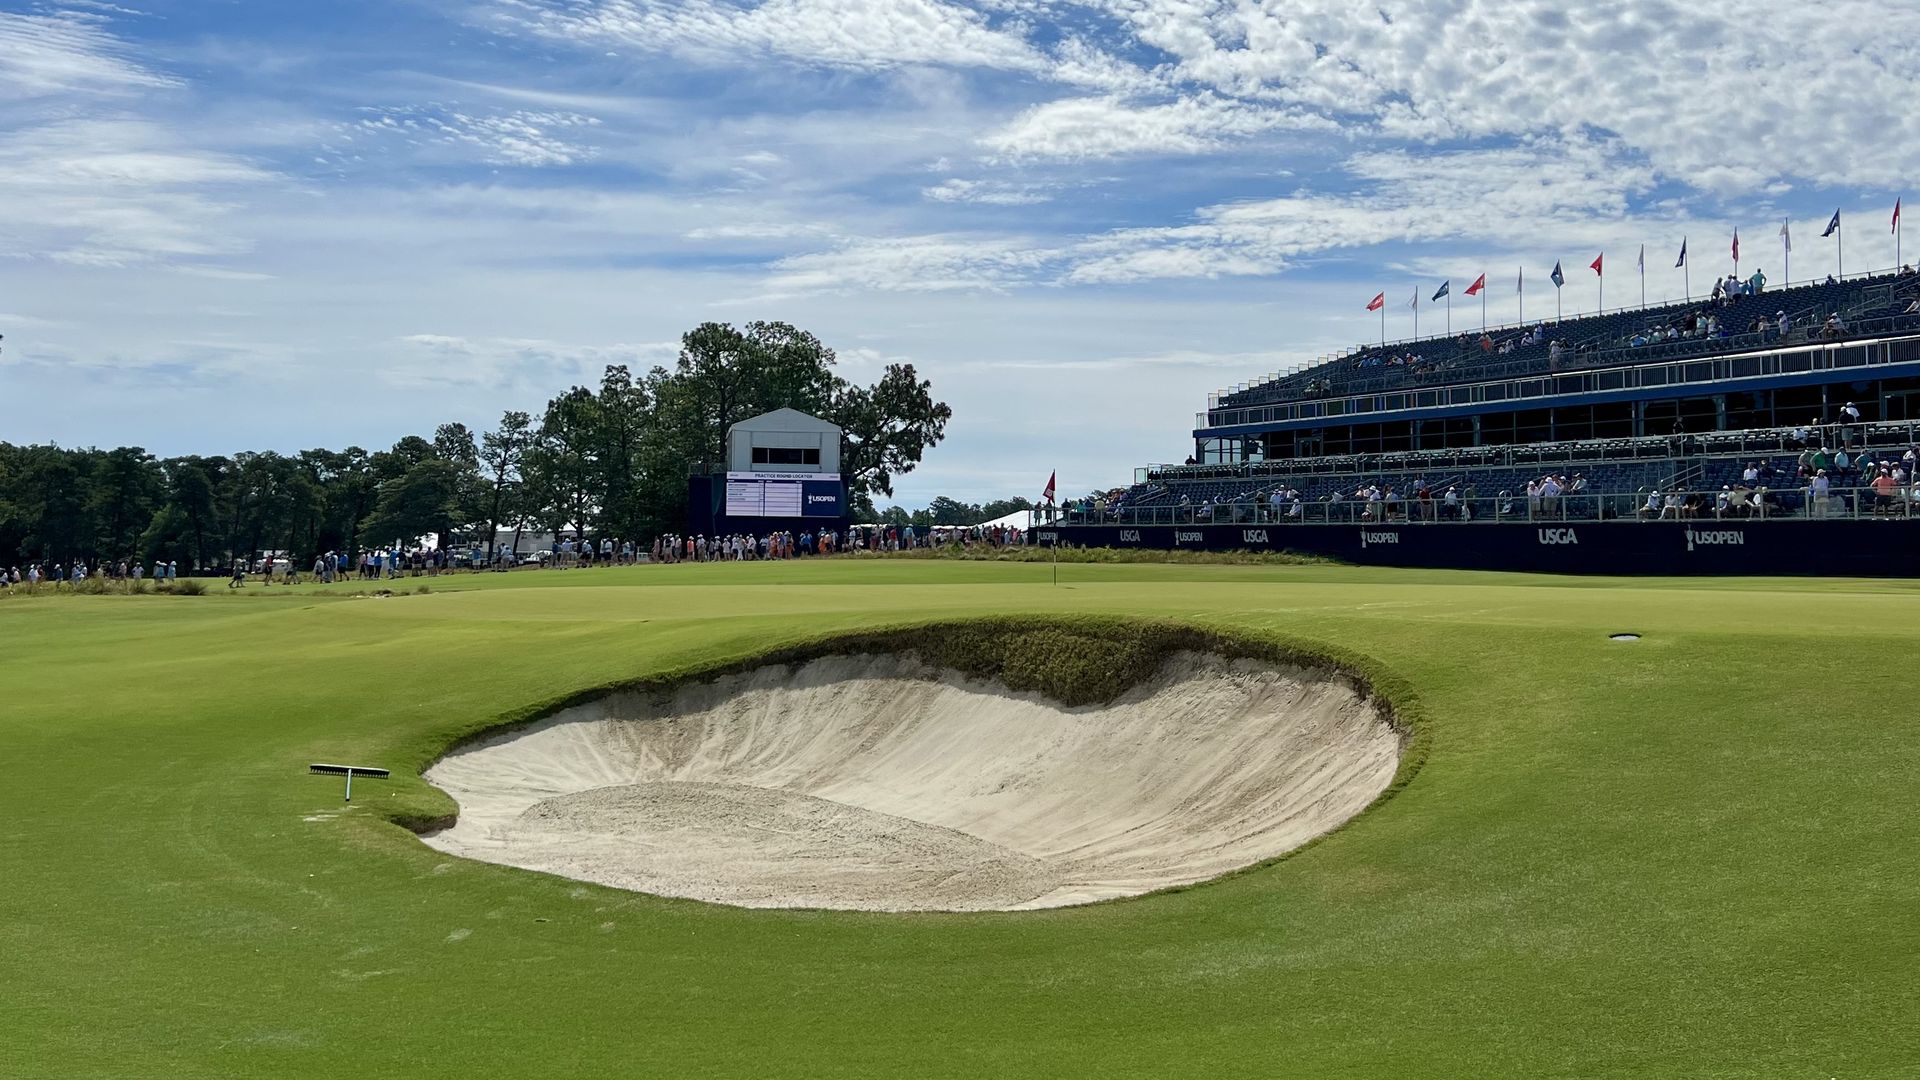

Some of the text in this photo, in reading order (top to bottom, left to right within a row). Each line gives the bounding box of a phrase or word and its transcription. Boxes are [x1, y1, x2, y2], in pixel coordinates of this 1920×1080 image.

[1119, 529, 1141, 542] USGA
[1243, 529, 1269, 543] USGA
[1538, 528, 1579, 545] USGA
